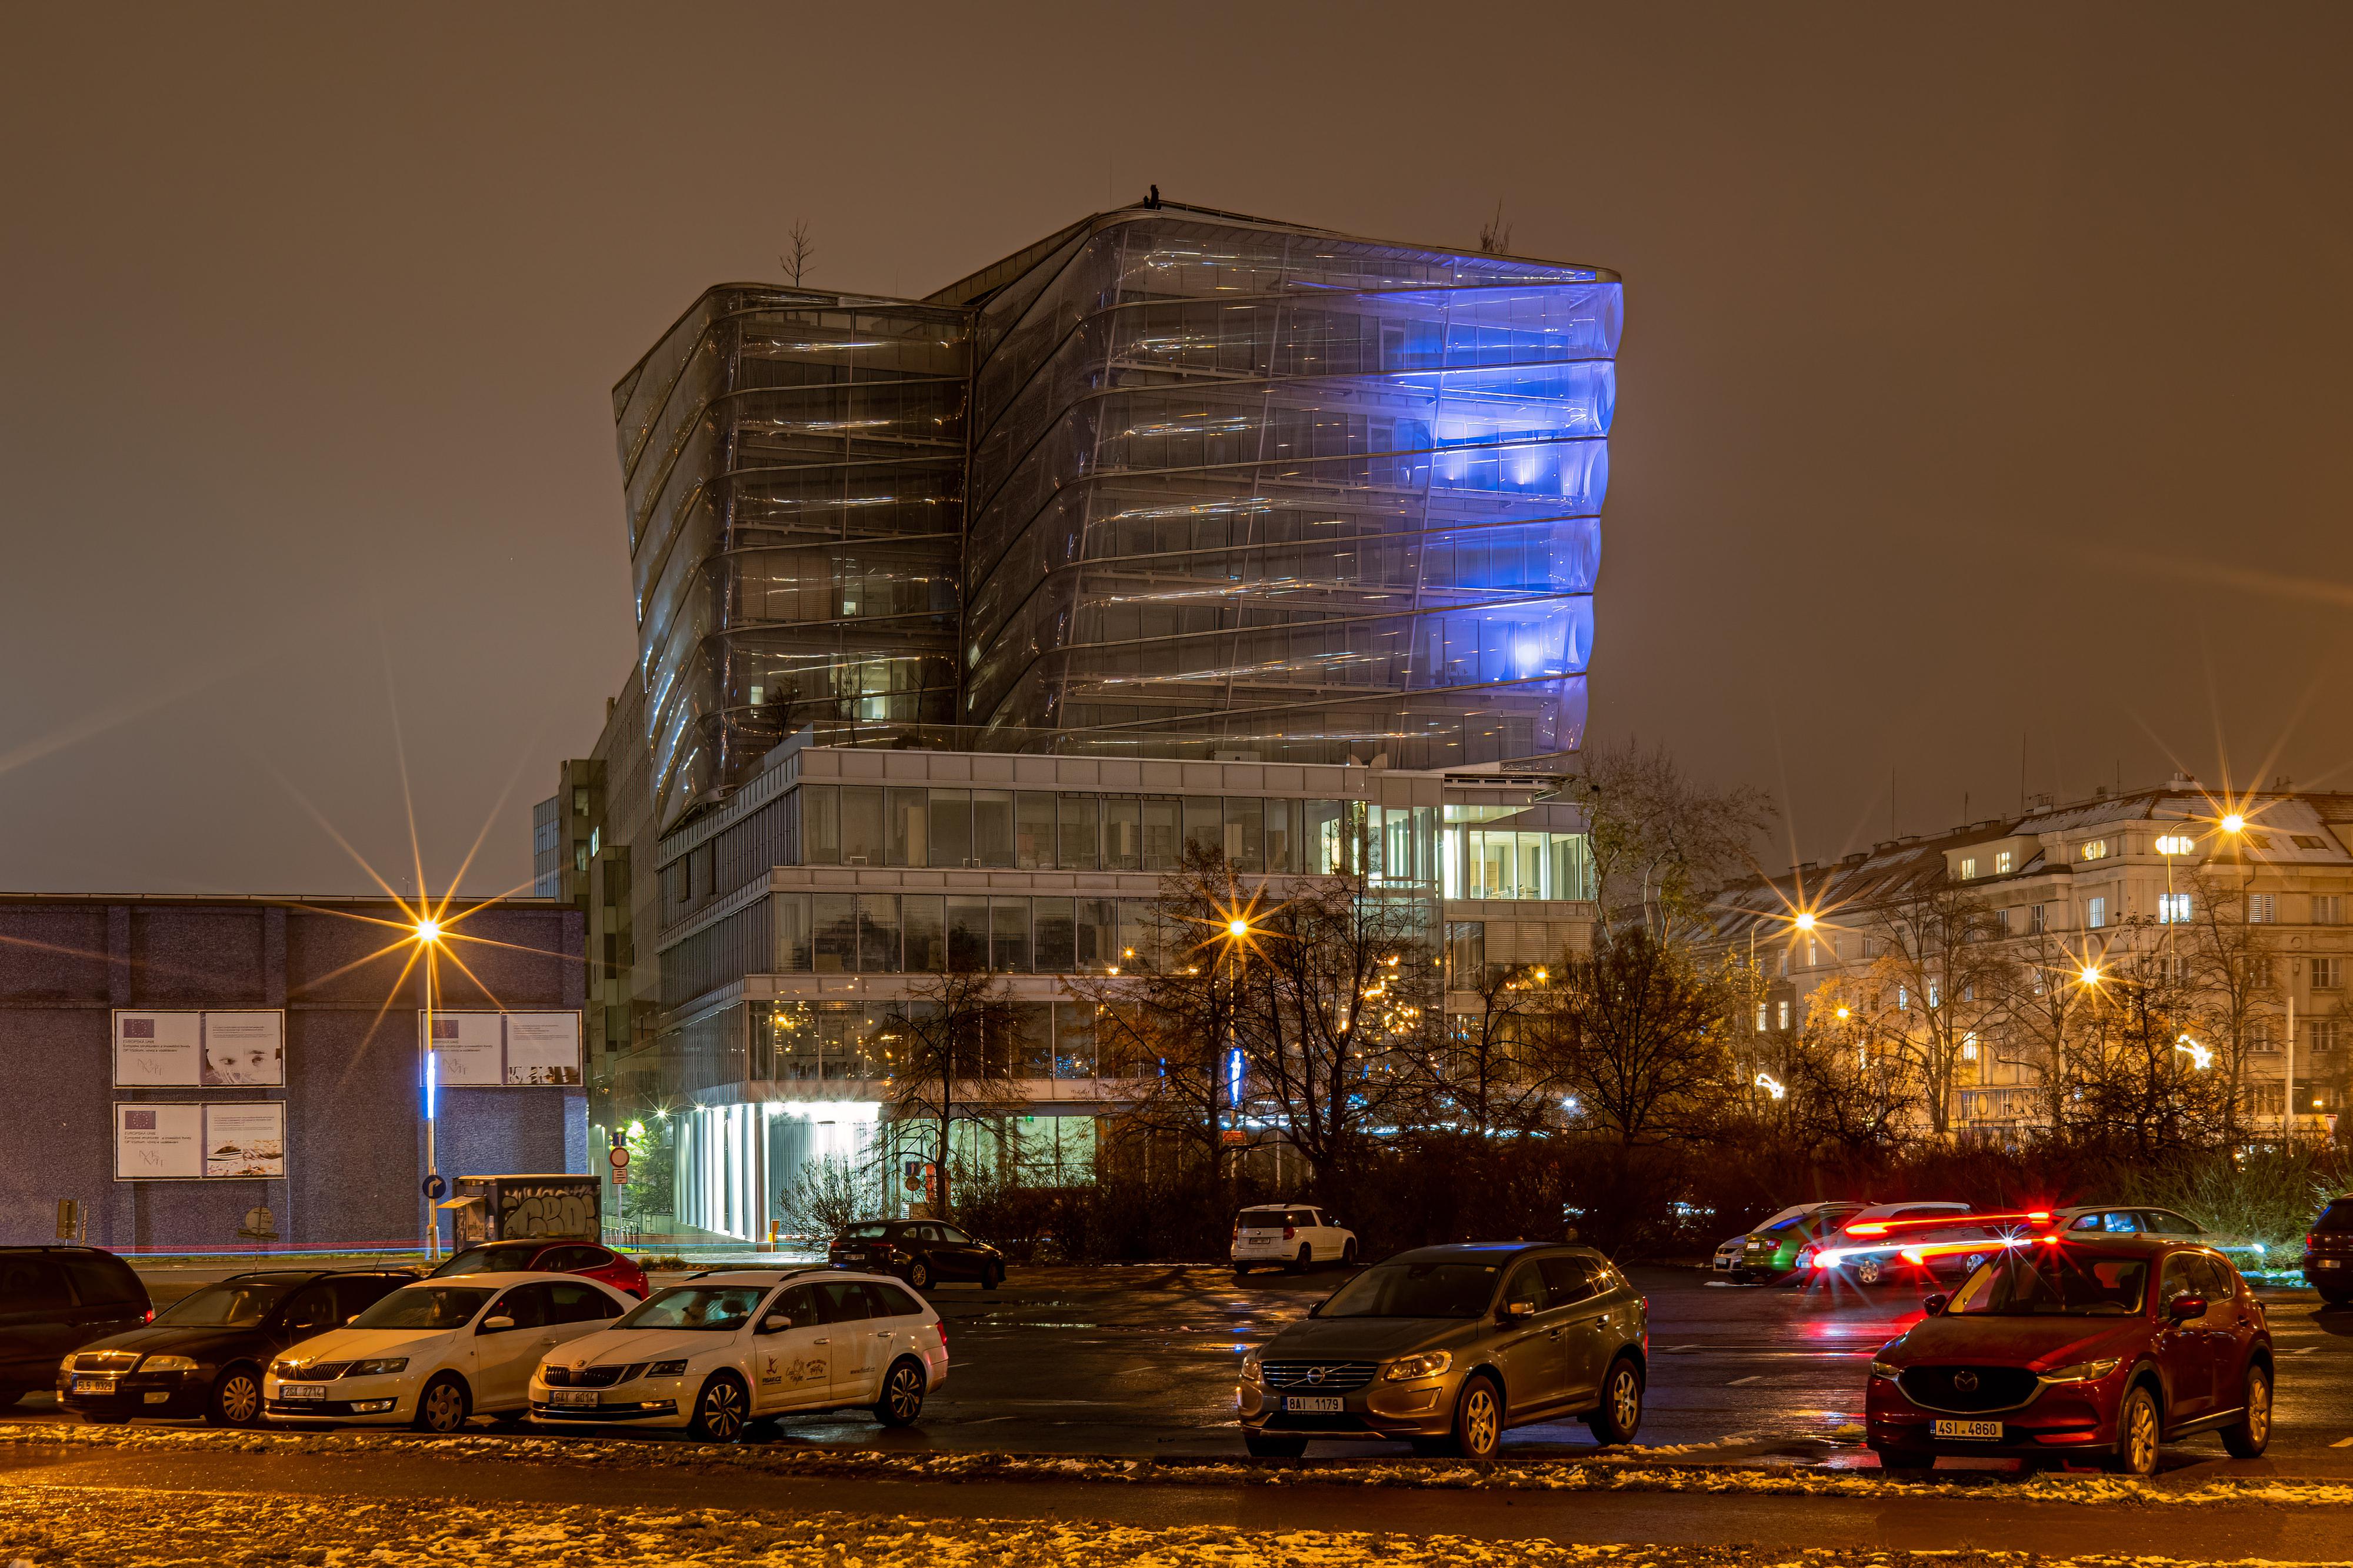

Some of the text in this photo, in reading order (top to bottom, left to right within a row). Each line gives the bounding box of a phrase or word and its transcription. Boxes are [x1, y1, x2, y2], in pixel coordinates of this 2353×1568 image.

[95, 1382, 112, 1390] 0329
[303, 1387, 322, 1397] 2714
[575, 1393, 594, 1402] 8014
[1289, 1398, 1338, 1410] 8AI 1179
[1939, 1422, 1997, 1435] 4SI 4860
